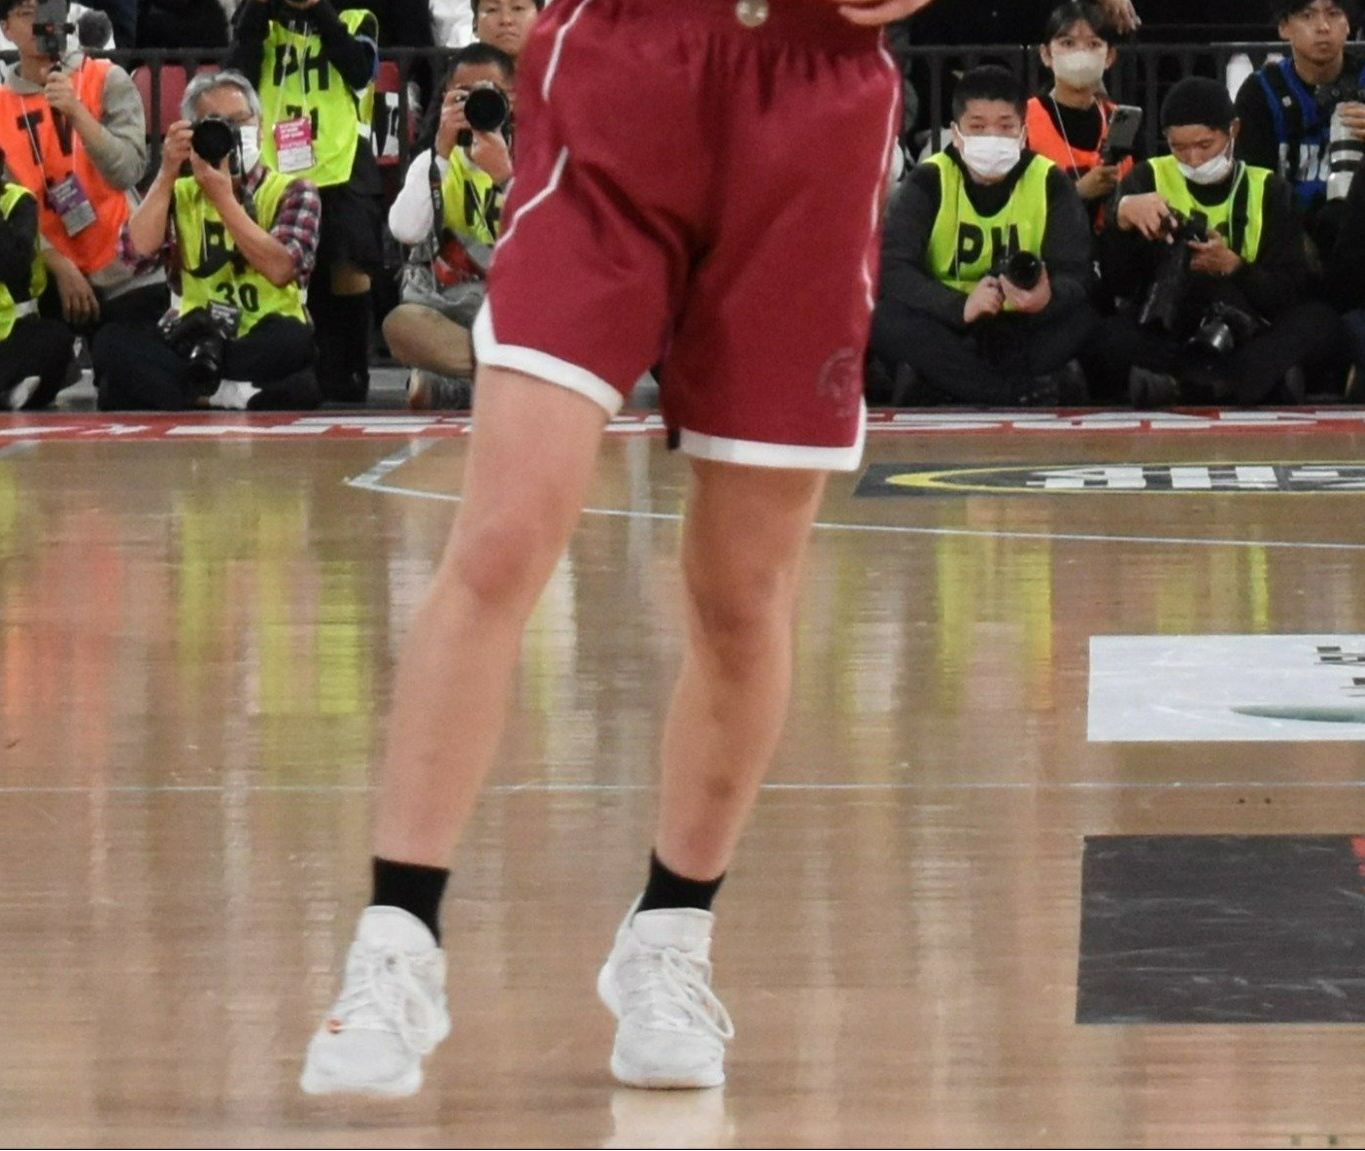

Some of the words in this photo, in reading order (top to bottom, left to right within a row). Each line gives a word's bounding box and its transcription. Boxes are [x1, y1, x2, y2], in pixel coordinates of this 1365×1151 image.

[273, 43, 330, 94] PH
[16, 107, 75, 166] TV
[948, 221, 1022, 277] PH
